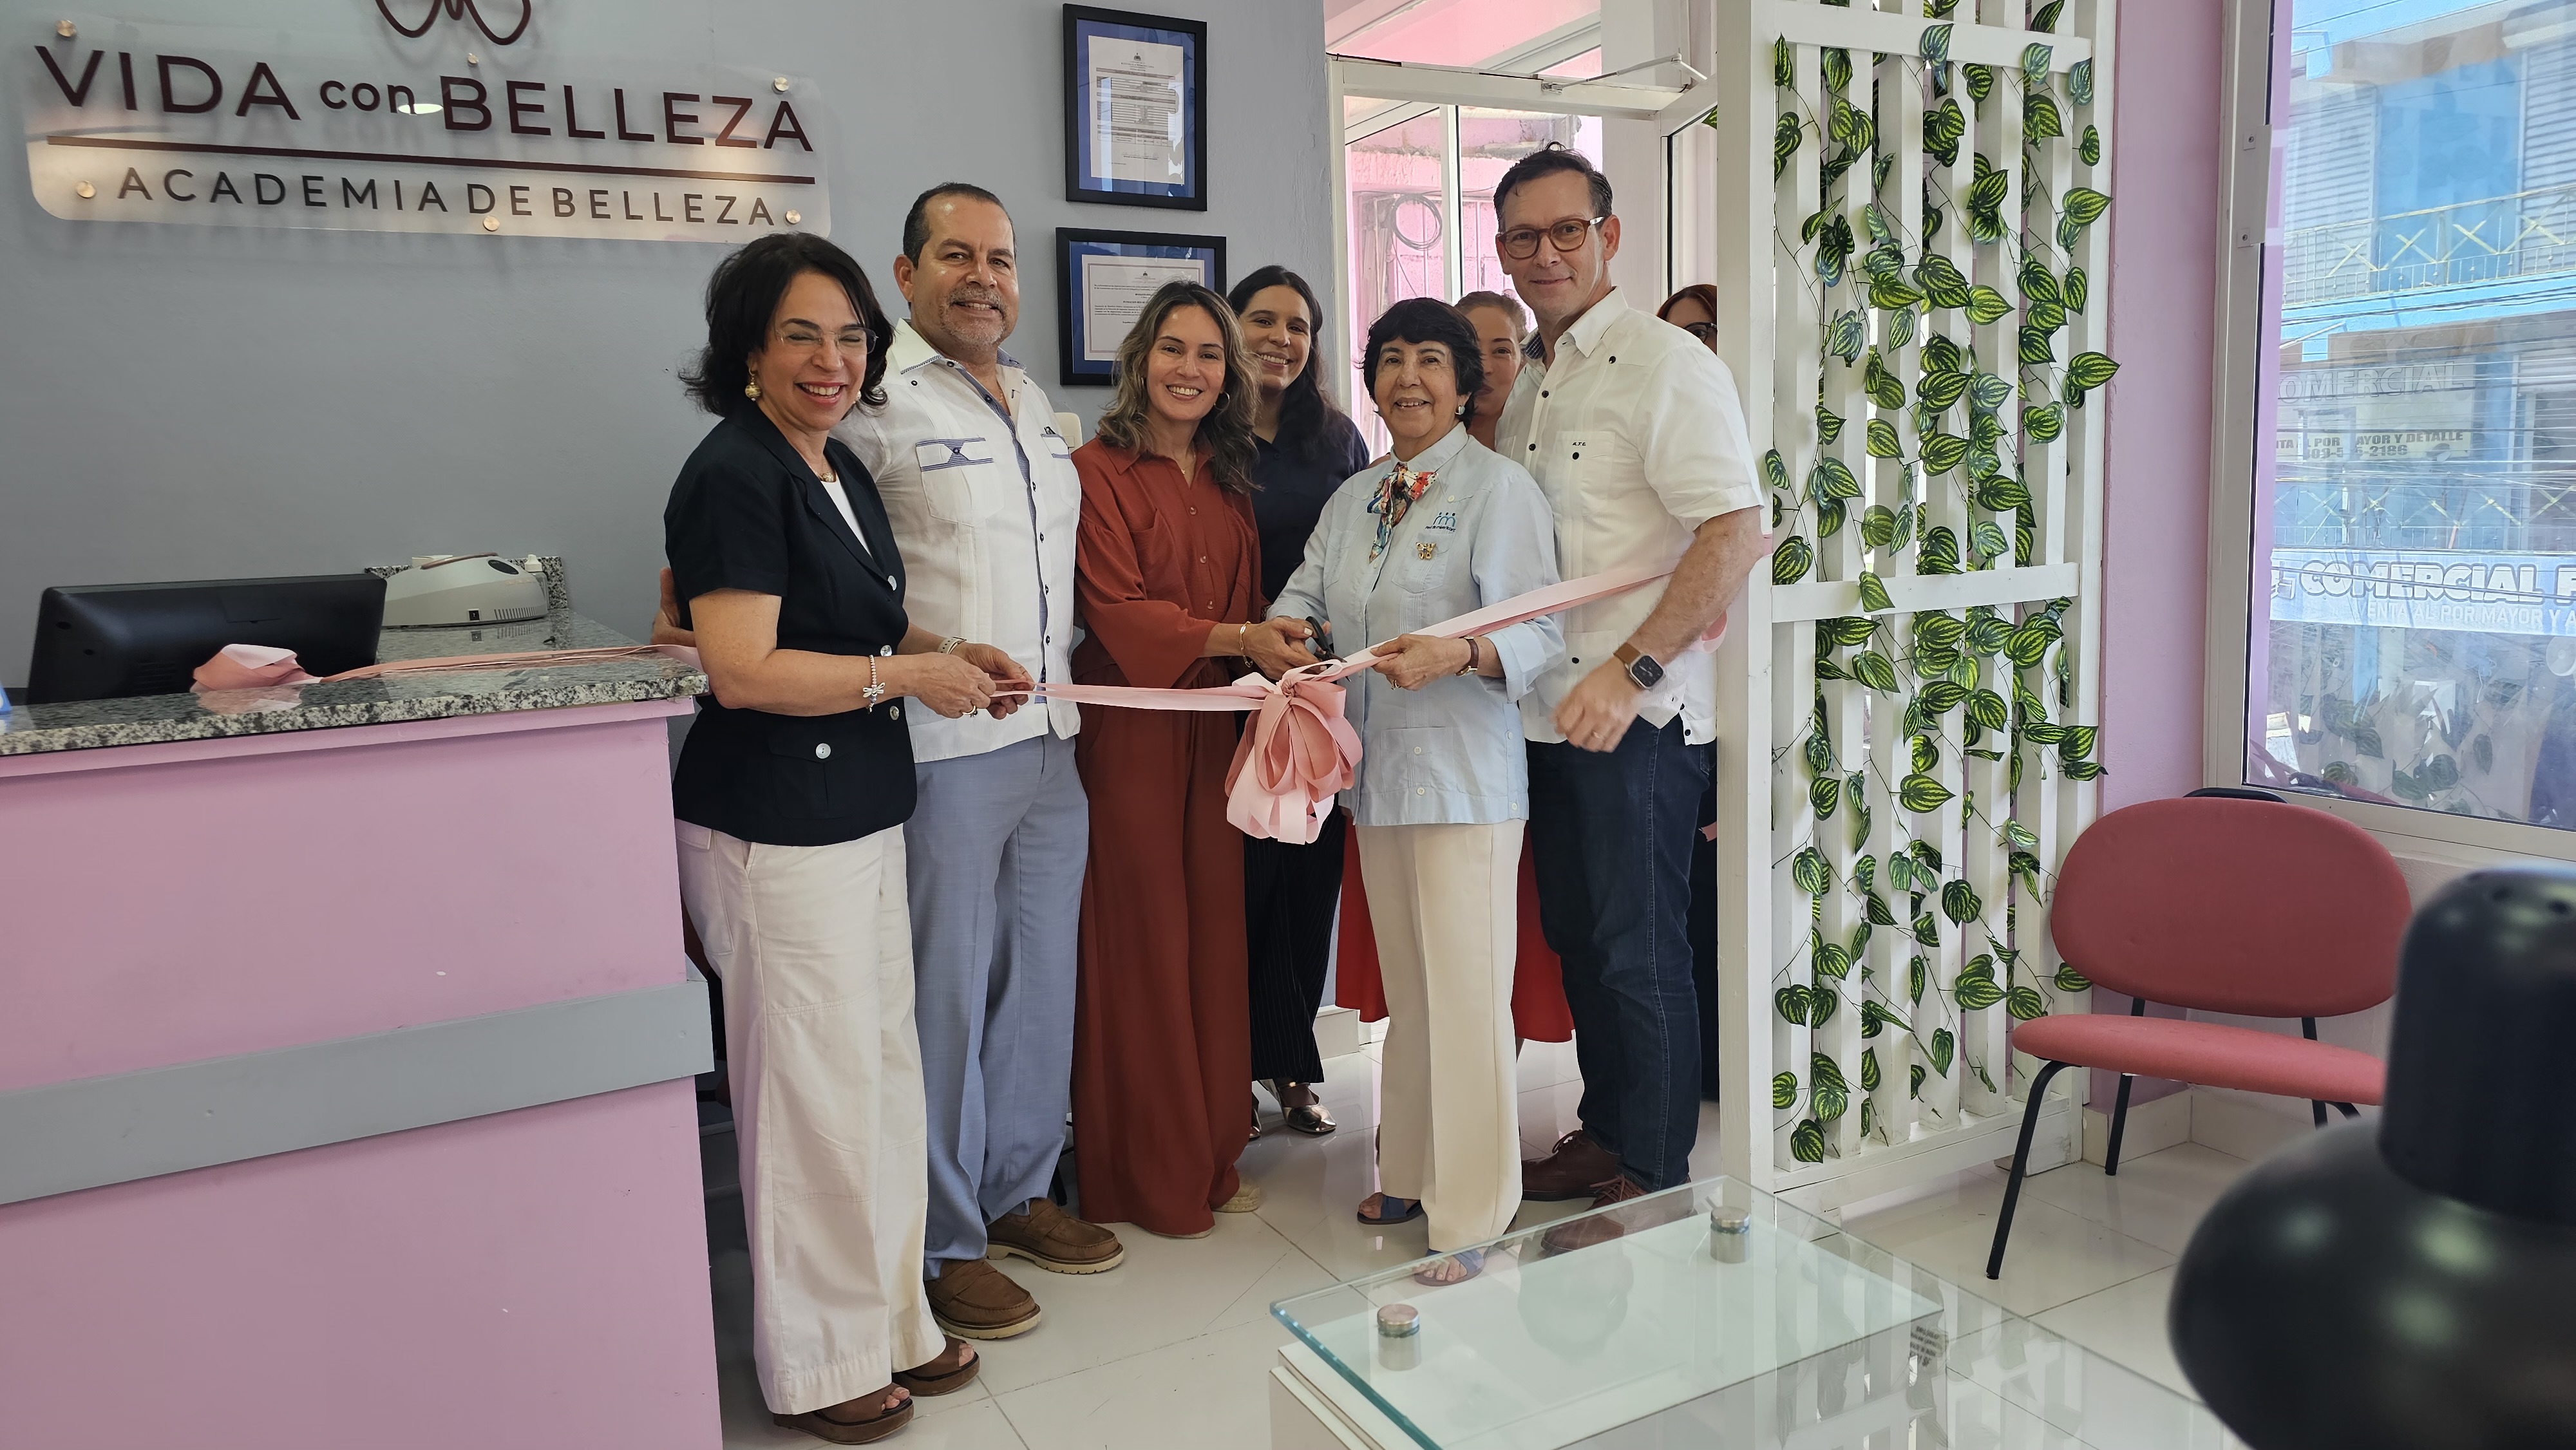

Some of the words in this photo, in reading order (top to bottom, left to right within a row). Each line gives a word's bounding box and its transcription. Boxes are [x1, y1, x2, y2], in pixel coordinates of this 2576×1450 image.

[34, 46, 301, 120] VIDA
[319, 80, 417, 115] con
[440, 75, 813, 152] BELLEZA
[117, 167, 448, 212] ACADEMIA
[467, 183, 532, 216] DE
[552, 187, 774, 226] BELLEZA
[2278, 361, 2464, 404] OMERCIAL
[2314, 437, 2340, 447] POR
[2356, 435, 2391, 445] AYOR
[2394, 434, 2403, 444] Y
[2406, 431, 2463, 443] DETALLE
[2299, 560, 2545, 605] COMERCIAL
[2414, 603, 2434, 621] AL
[2440, 605, 2475, 624] POR
[2481, 607, 2543, 626] MAYOR
[2548, 608, 2561, 628] Y
